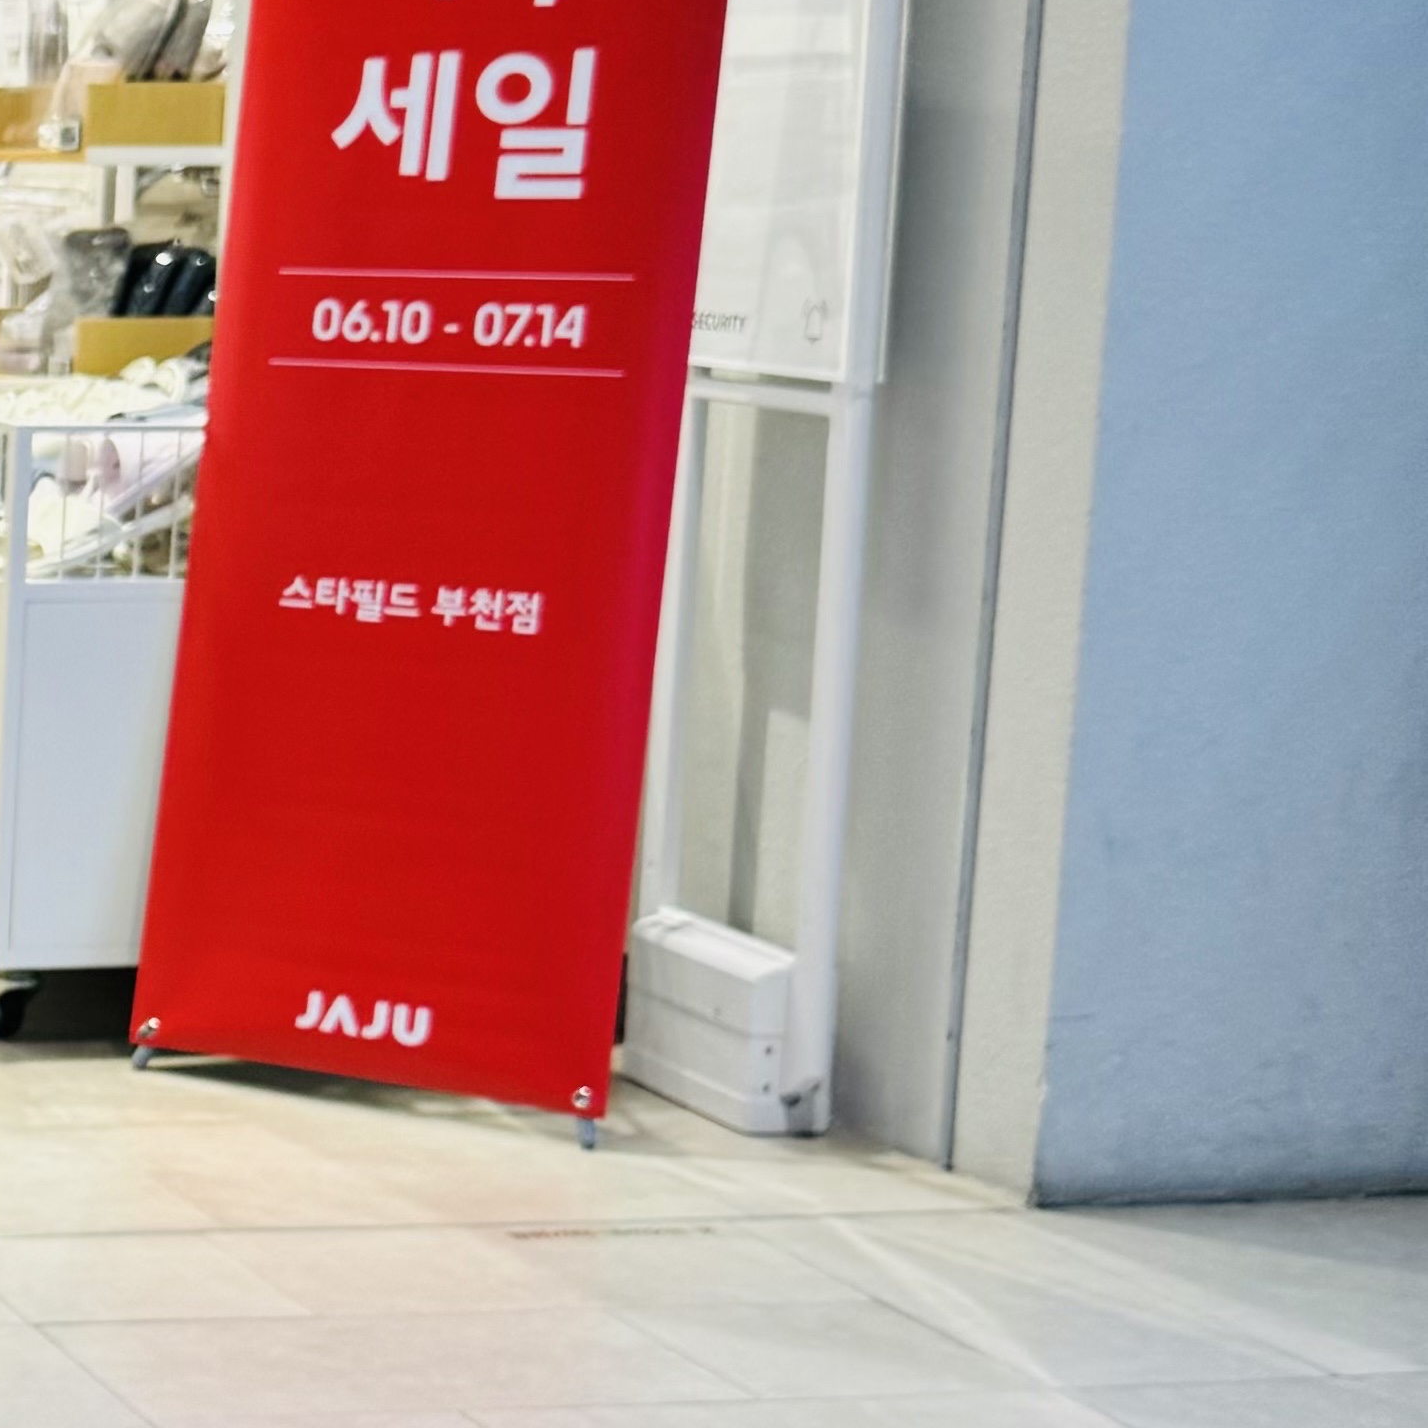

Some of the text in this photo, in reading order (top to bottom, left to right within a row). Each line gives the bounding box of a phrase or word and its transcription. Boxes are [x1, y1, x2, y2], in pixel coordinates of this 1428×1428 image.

[331, 46, 598, 201] 세일
[311, 297, 432, 344] 06.10
[472, 302, 588, 349] 07.14
[277, 575, 543, 636] 스타필드 부천점
[295, 989, 433, 1047] JAJU
